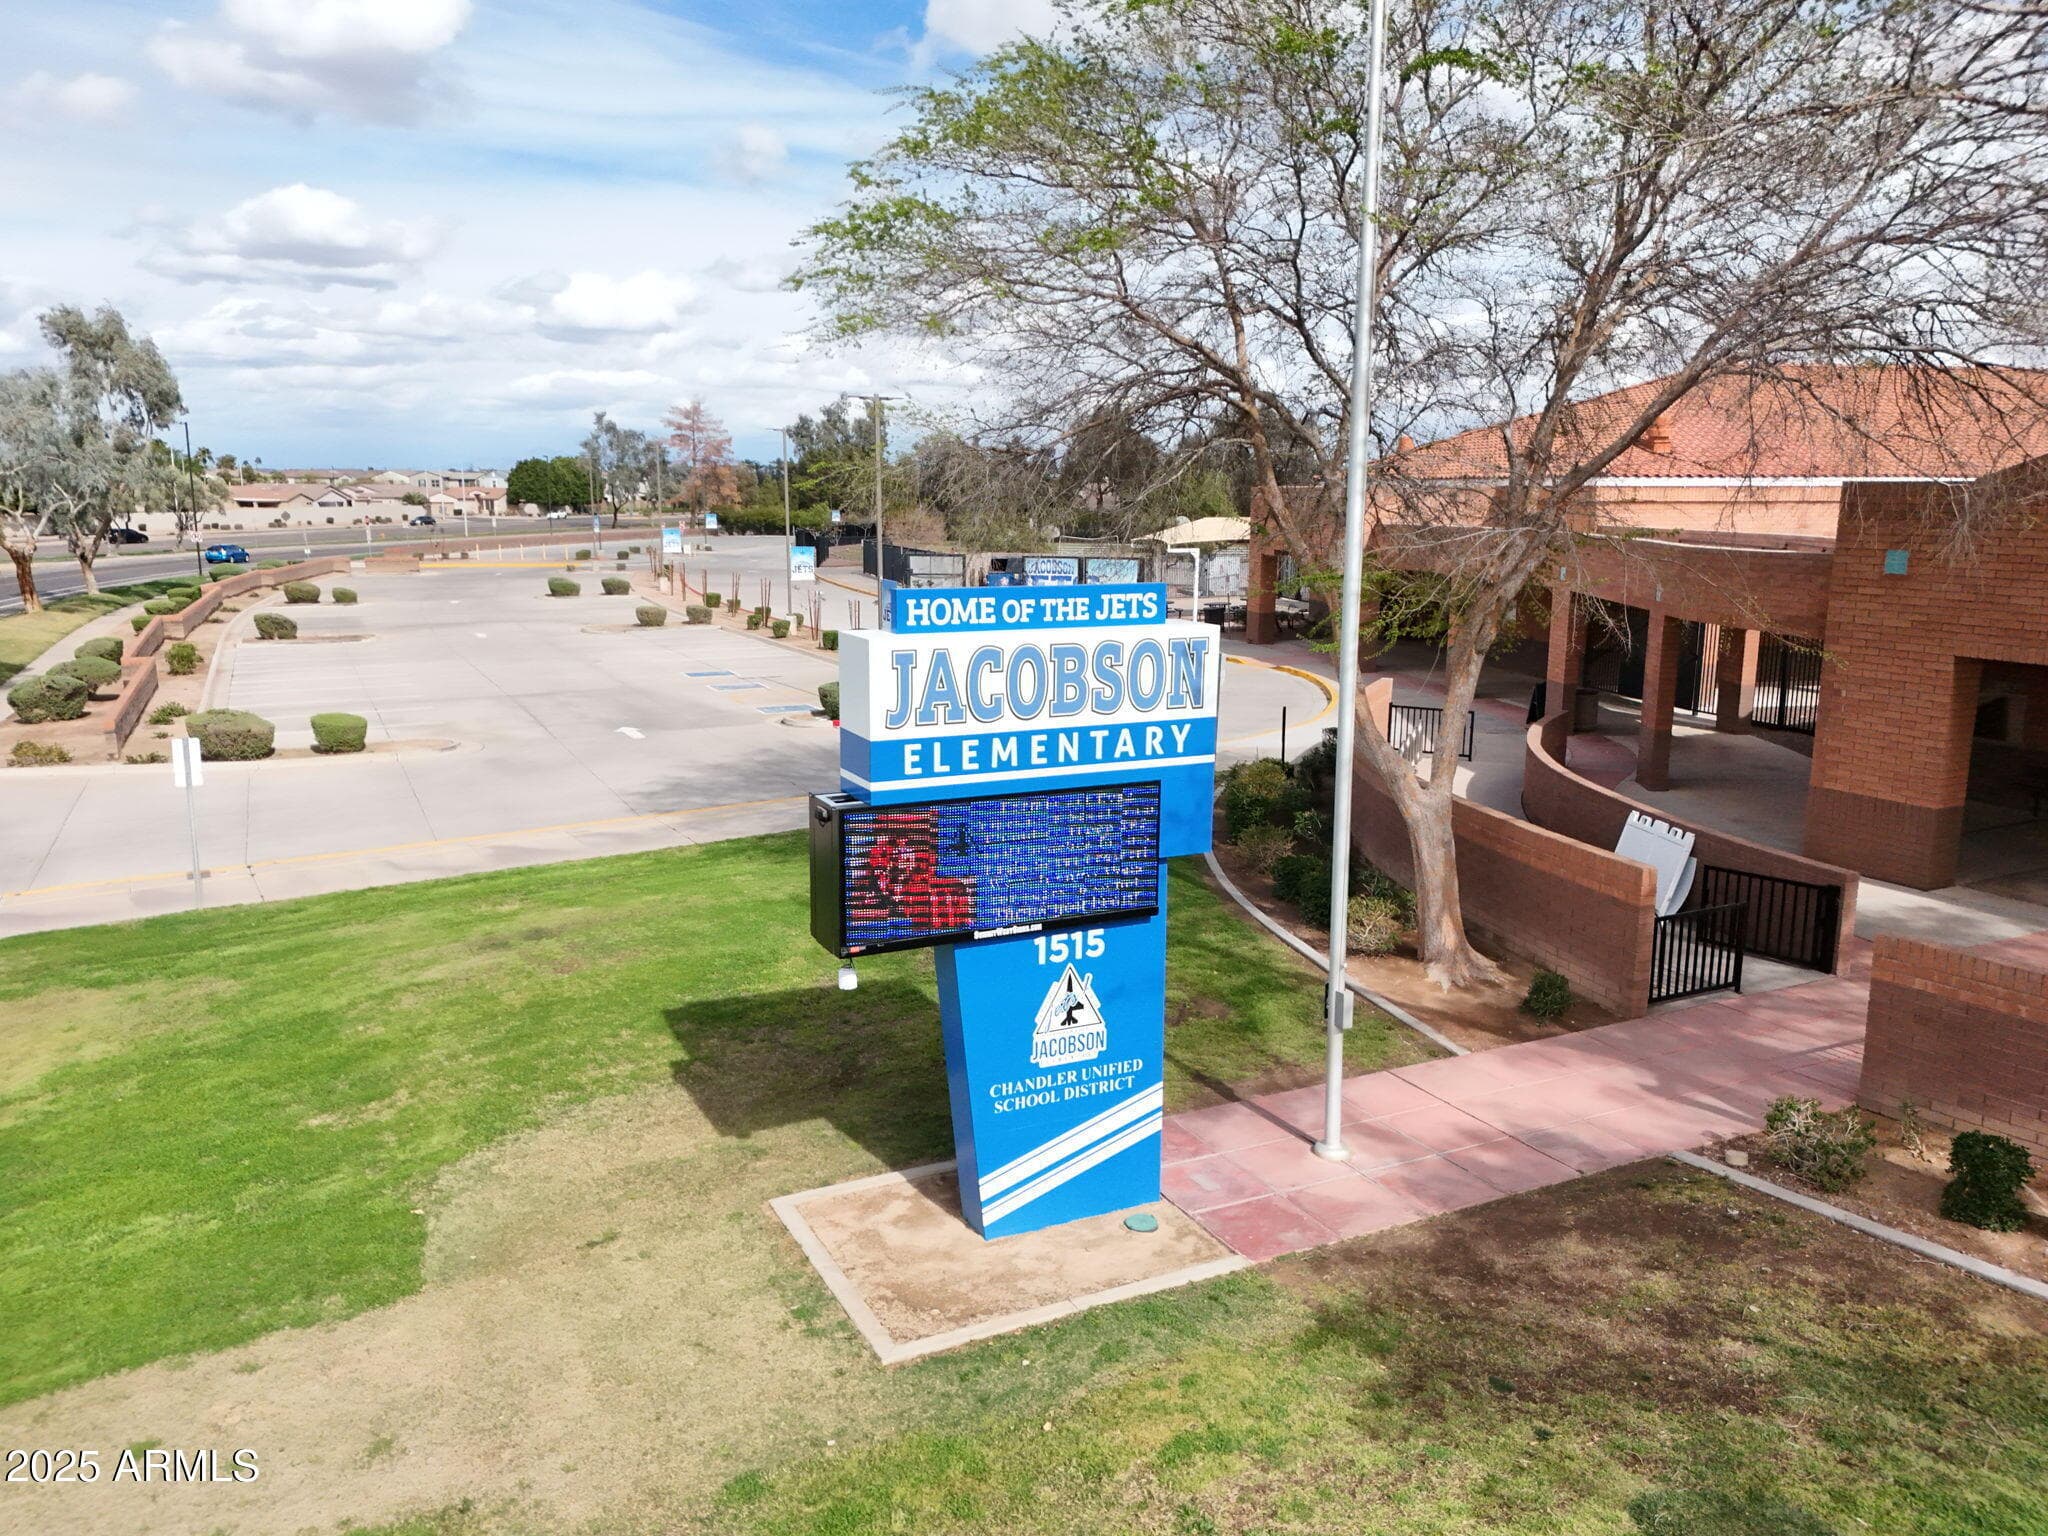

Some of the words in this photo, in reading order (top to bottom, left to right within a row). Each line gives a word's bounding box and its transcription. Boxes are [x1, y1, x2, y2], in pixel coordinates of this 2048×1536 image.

[792, 564, 814, 574] JETS
[906, 598, 997, 626] HOME
[1003, 599, 1036, 623] OF
[1041, 597, 1091, 622] THE
[1096, 593, 1158, 620] JETS
[886, 638, 1208, 729] JACOBSON
[904, 725, 1192, 775] ELEMENTARY
[1035, 929, 1105, 965] 1515
[1033, 1030, 1104, 1060] JACOBSON
[991, 1070, 1077, 1098] CHANDLER
[1083, 1058, 1143, 1078] UNIFIED
[994, 1089, 1061, 1114] SCHOOL
[1065, 1077, 1134, 1100] DISTRICT
